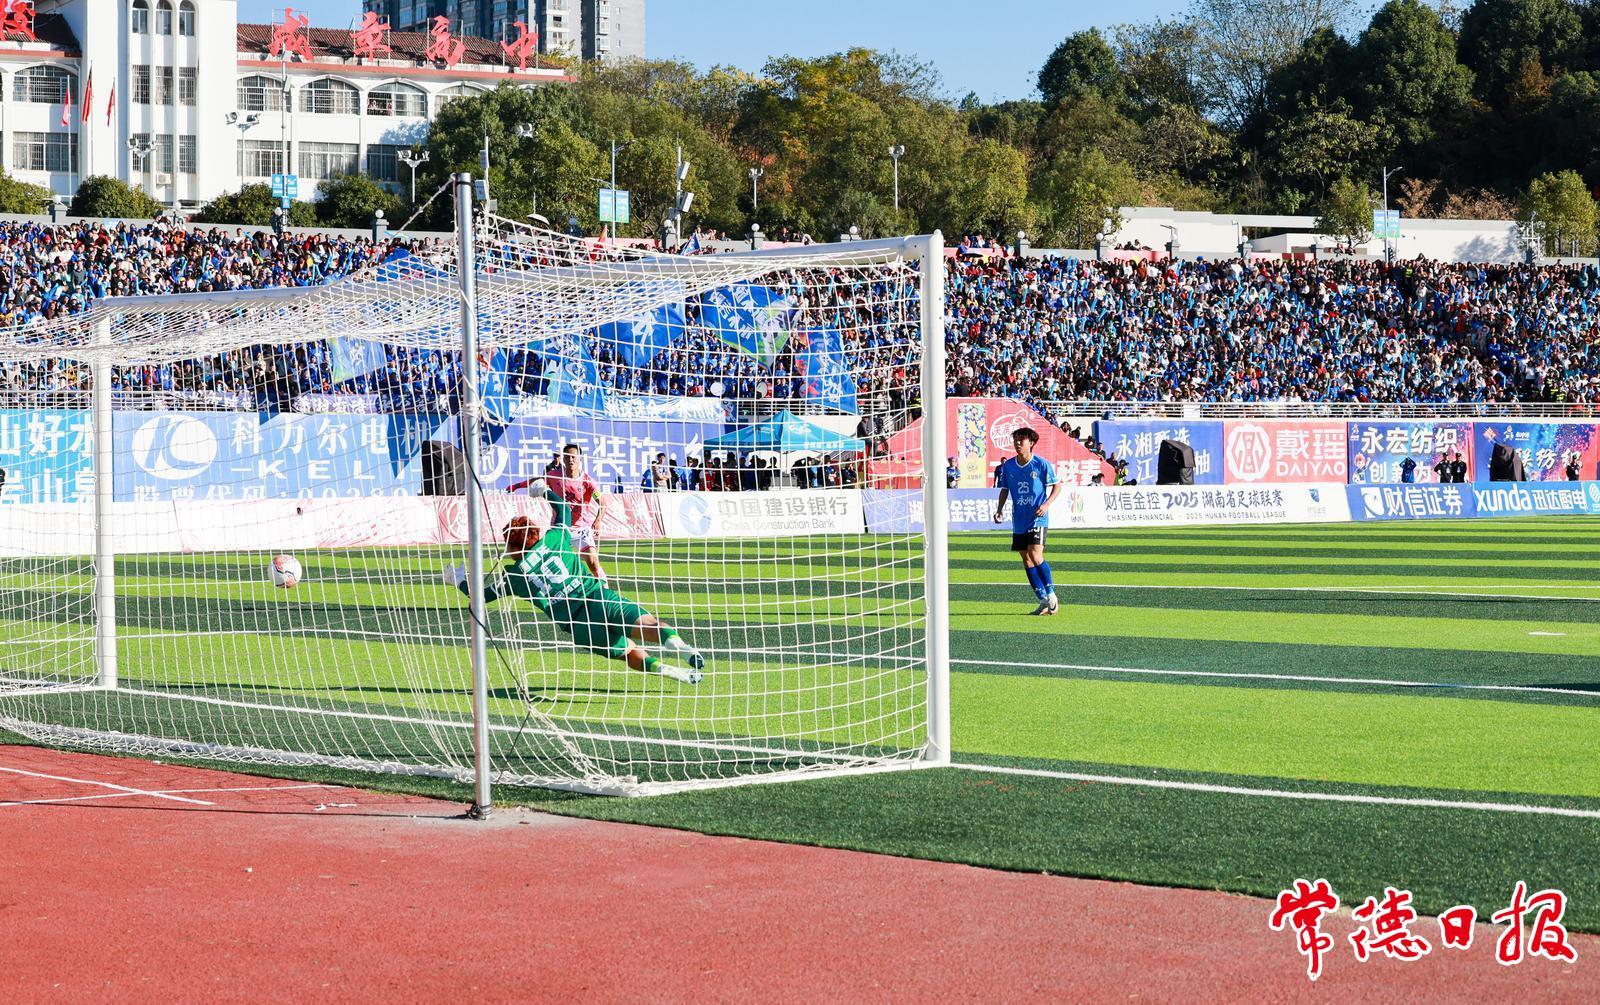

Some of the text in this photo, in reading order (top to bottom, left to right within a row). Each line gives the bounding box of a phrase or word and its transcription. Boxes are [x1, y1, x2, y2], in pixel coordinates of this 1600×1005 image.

[1275, 429, 1346, 459] 戴瑶
[1361, 426, 1459, 456] 永宏纺织
[1276, 461, 1346, 478] DAIYAO
[718, 496, 848, 517] 中国建设银行
[1104, 491, 1161, 511] 财信金控
[1163, 493, 1200, 509] 2025
[1383, 486, 1463, 517] 财信证券
[1474, 483, 1532, 513] xunda
[721, 517, 836, 531] China Construction Bank
[1107, 514, 1137, 522] CHASING
[1139, 513, 1174, 521] FINANCIAL
[1205, 512, 1228, 520] HUNAN
[1229, 511, 1262, 520] FOOTBALL
[1263, 510, 1287, 519] LEAGUE
